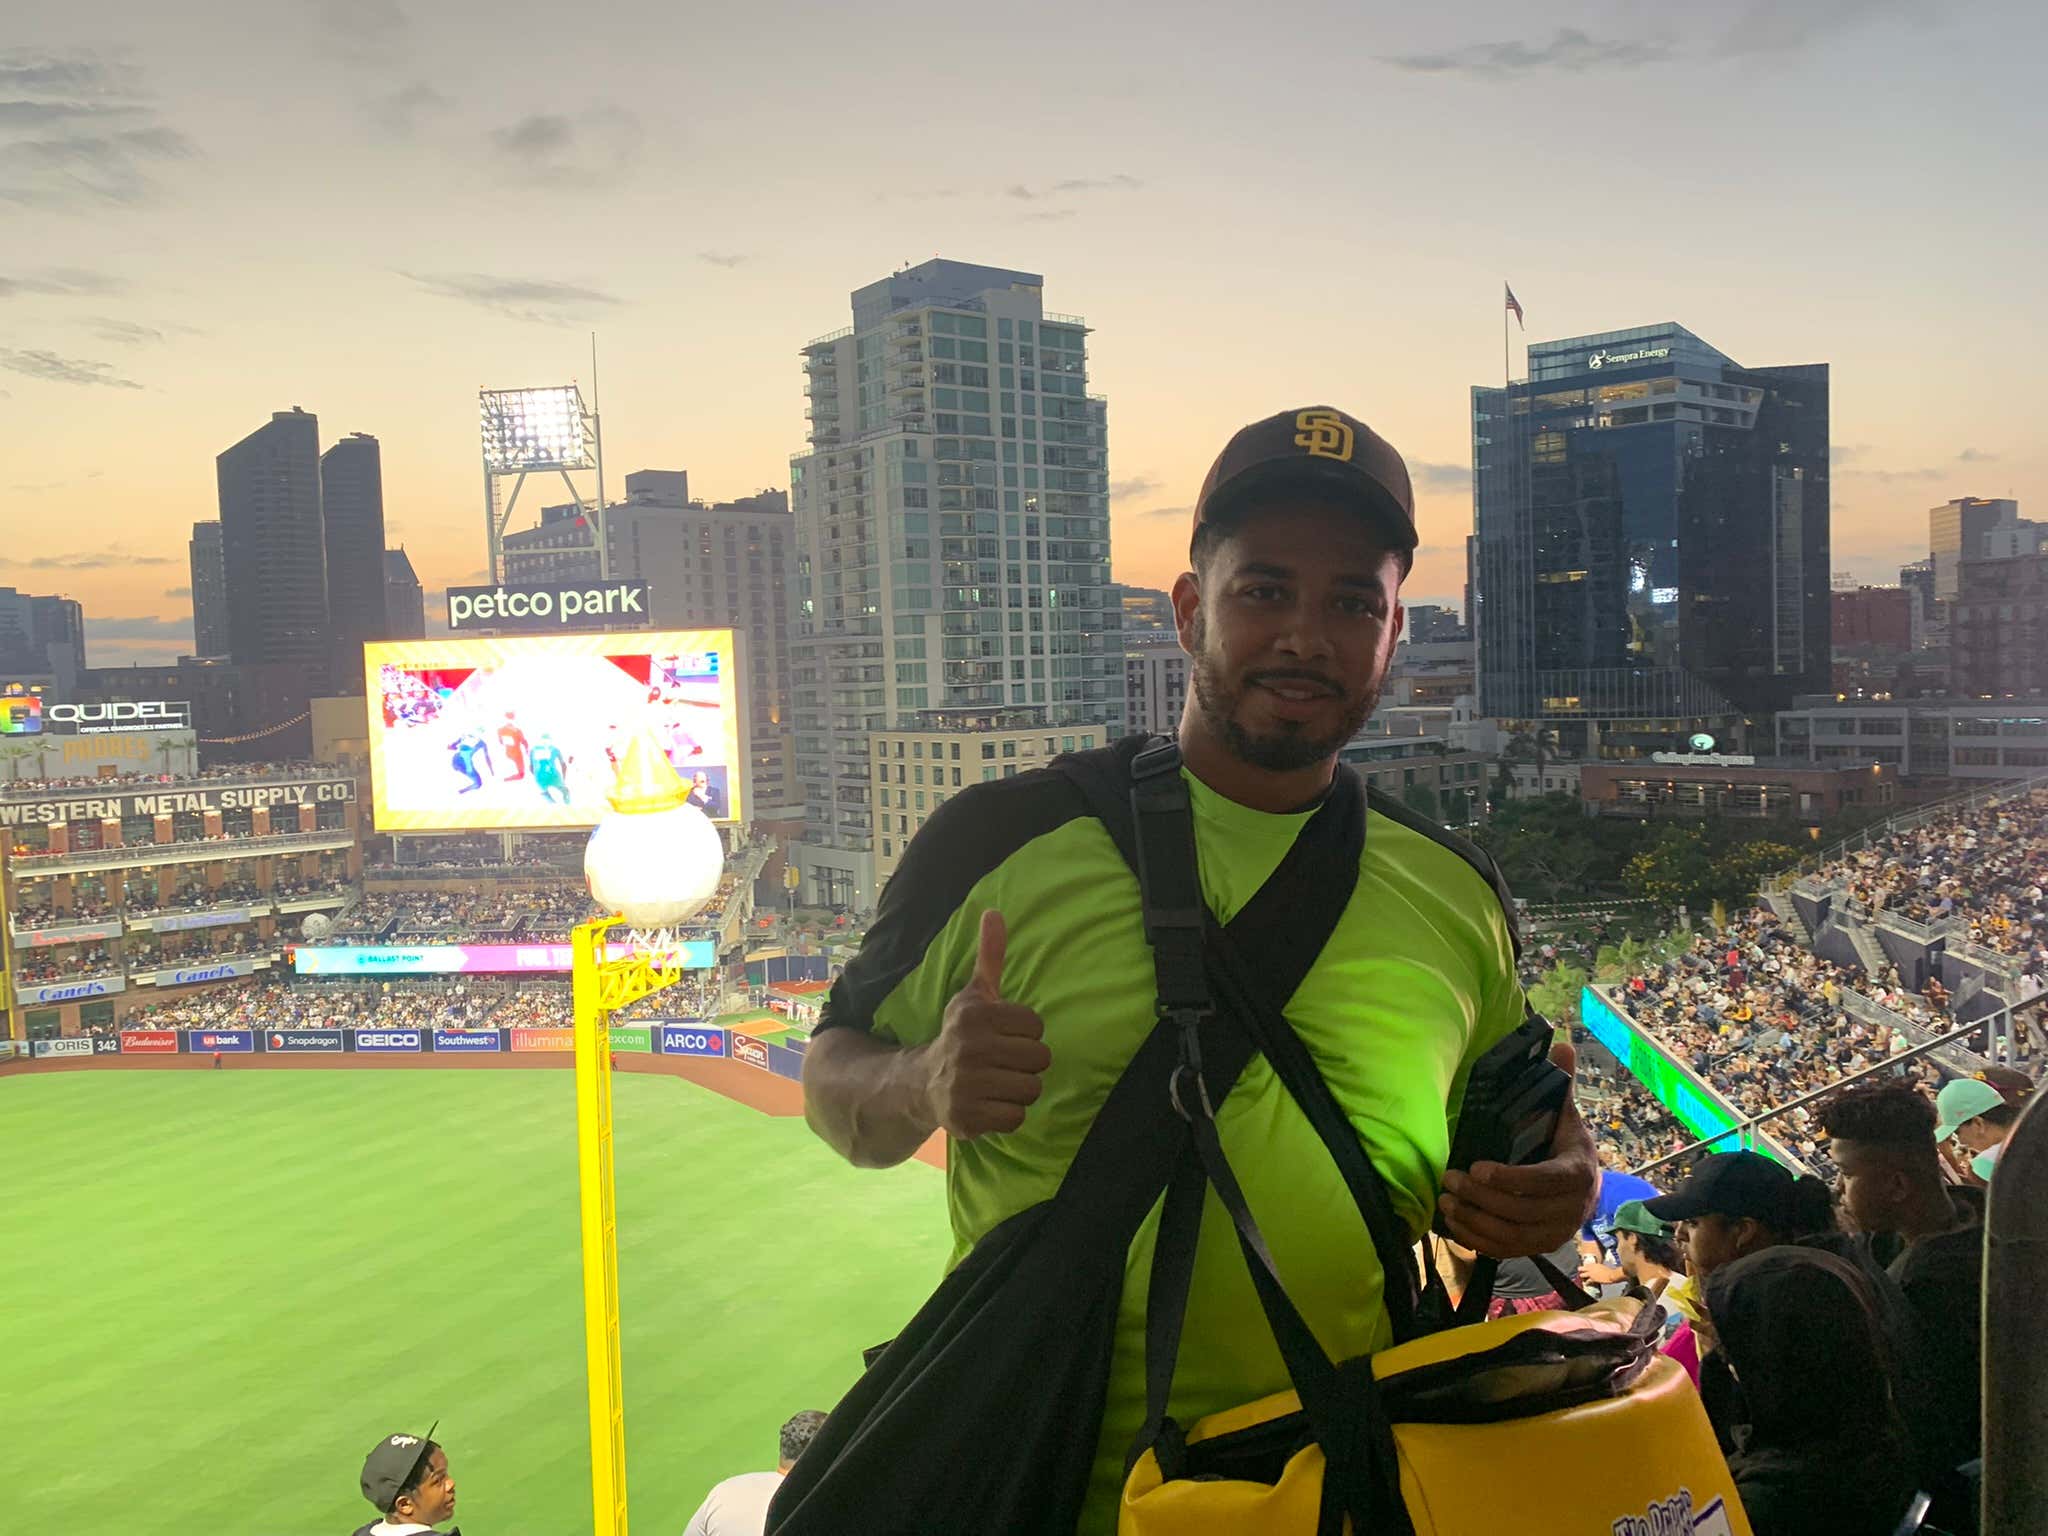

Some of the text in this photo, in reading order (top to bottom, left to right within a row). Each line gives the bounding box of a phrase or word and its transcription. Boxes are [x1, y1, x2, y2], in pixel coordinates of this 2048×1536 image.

[1606, 347, 1669, 363] Sempra Energy
[449, 585, 643, 627] petco park
[49, 702, 183, 723] QUIDEL
[64, 735, 150, 764] PADRES
[0, 783, 355, 825] WESTERN METAL SUPPLY CO.
[55, 1039, 90, 1051] ORIS
[97, 1040, 117, 1052] 342
[123, 1035, 175, 1048] Budweiser
[288, 1035, 338, 1047] Snapdragon
[357, 1034, 419, 1047] GEICO
[437, 1034, 489, 1045] Southwest
[609, 1034, 645, 1045] excom
[664, 1033, 706, 1050] ARCO
